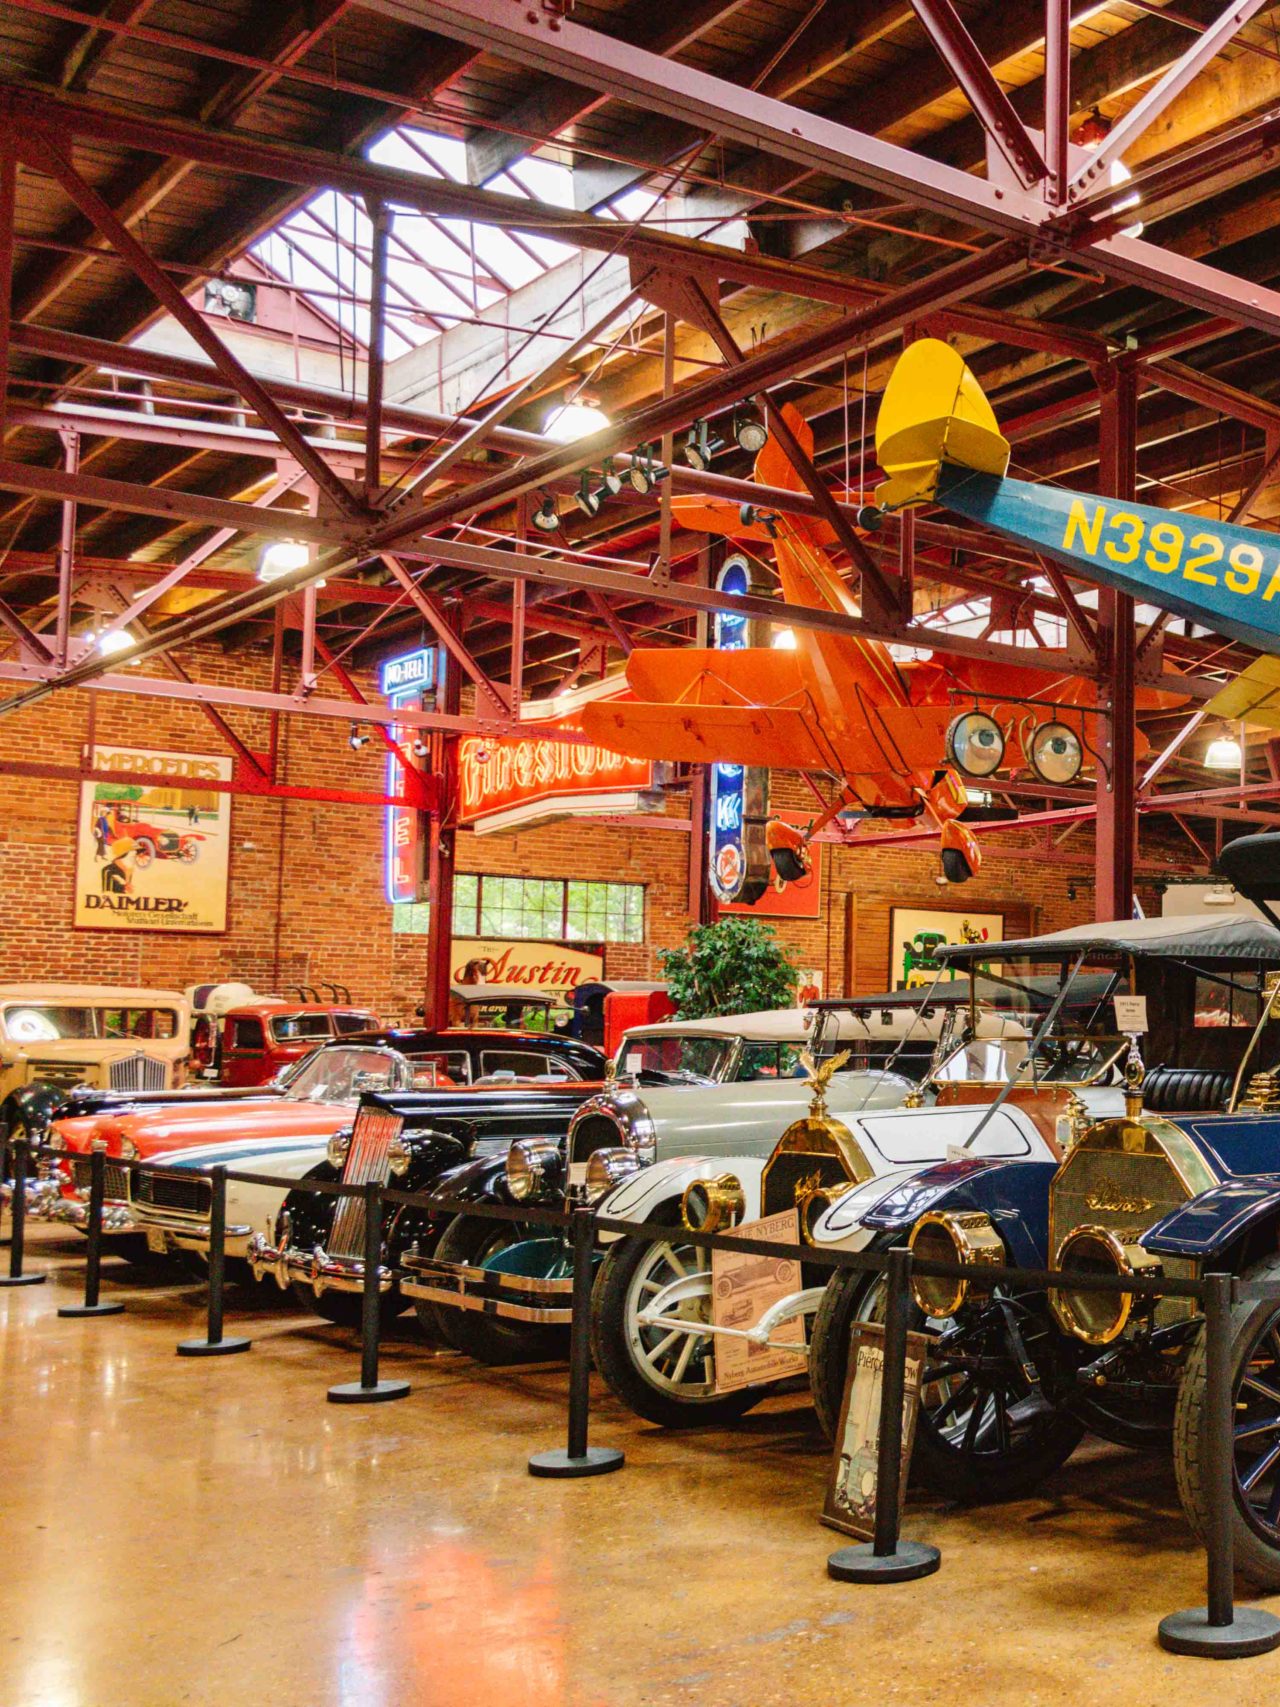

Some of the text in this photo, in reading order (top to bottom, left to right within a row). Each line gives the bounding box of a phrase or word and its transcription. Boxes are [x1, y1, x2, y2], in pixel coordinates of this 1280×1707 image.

[387, 658, 425, 684] NO-TELL
[95, 752, 221, 780] MERCEDES
[460, 722, 646, 806] Fireston
[454, 947, 582, 987] Austin
[756, 1216, 795, 1237] NYBERG
